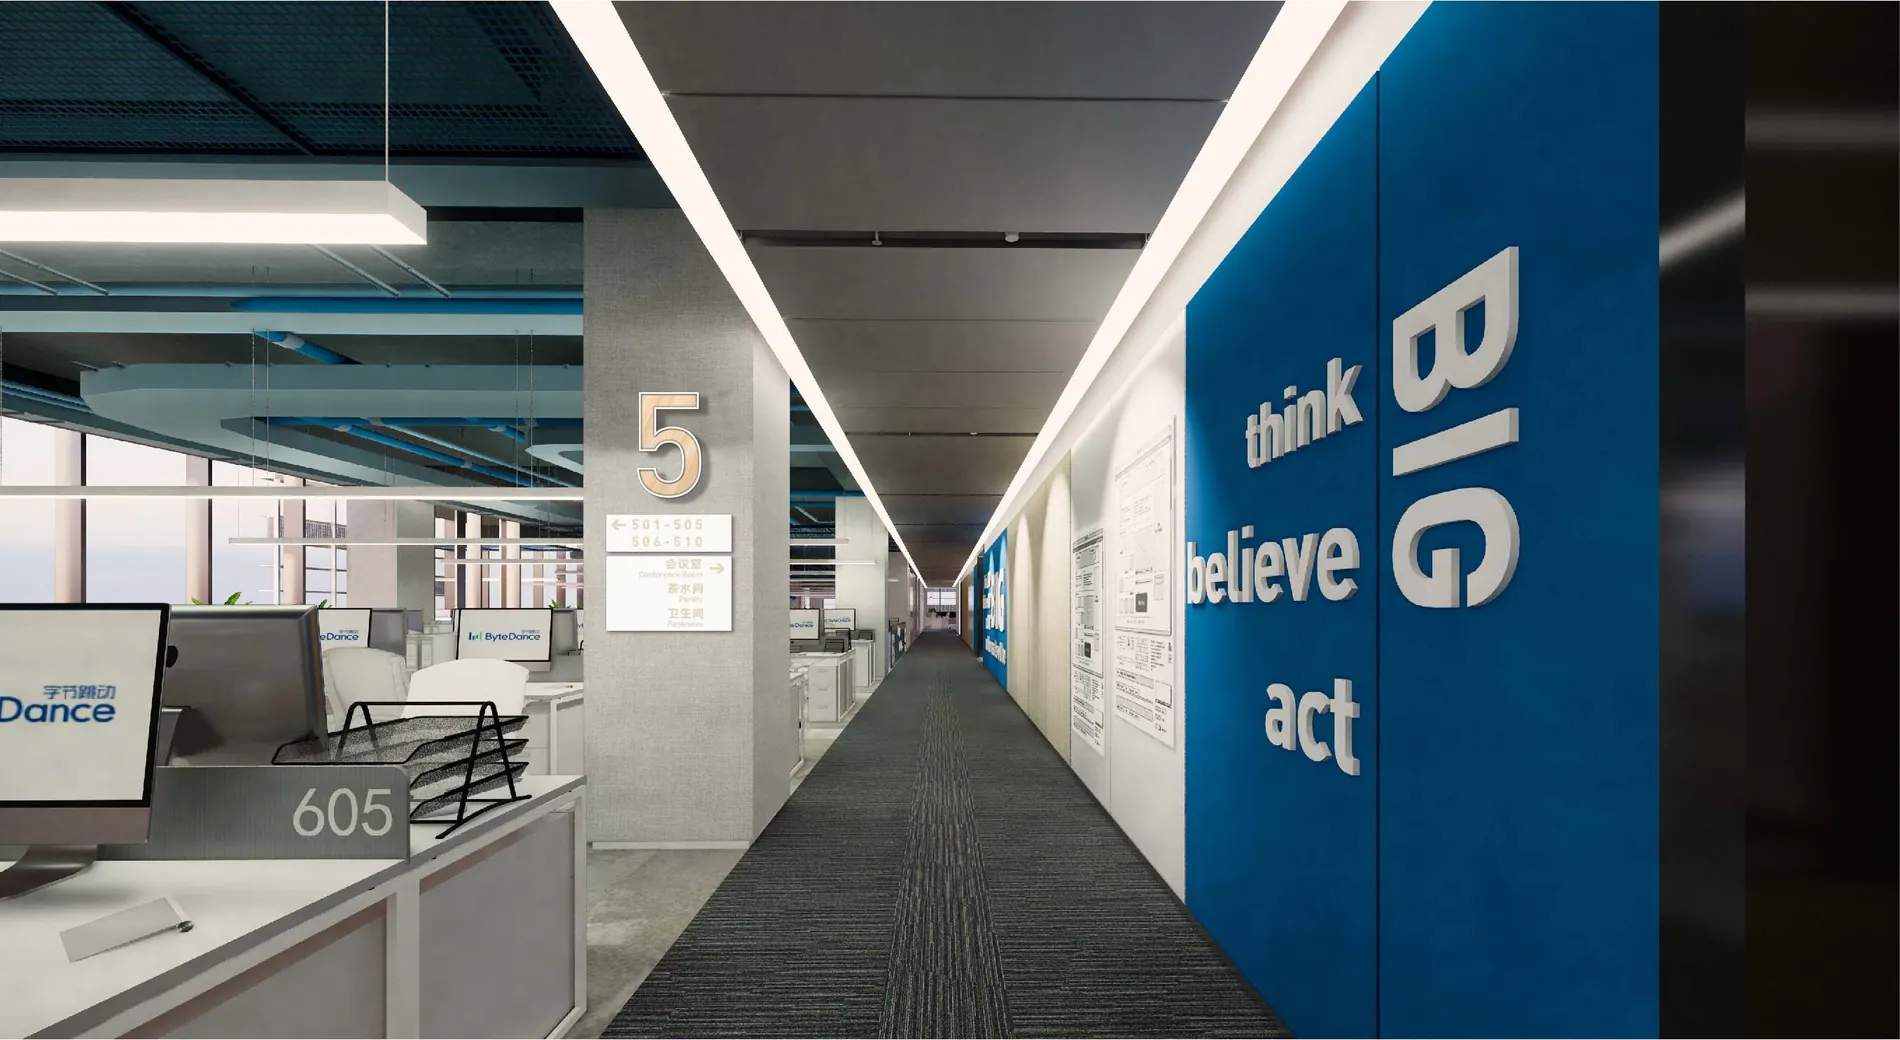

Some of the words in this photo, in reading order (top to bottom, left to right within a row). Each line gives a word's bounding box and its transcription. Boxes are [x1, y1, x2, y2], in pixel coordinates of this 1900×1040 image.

[1246, 357, 1363, 468] think
[1392, 246, 1520, 608] BIG
[637, 392, 702, 498] 5
[632, 518, 702, 530] 501-505
[632, 536, 702, 547] 506-510
[665, 558, 703, 569] 会议室
[1187, 525, 1360, 604] believe
[667, 582, 704, 594] 茶水间
[678, 595, 703, 605] Pantry
[667, 607, 704, 619] 卫生间
[485, 632, 541, 642] ByteDance
[43, 685, 116, 700] 字节跳动
[1265, 678, 1360, 776] act
[293, 788, 393, 836] 605
